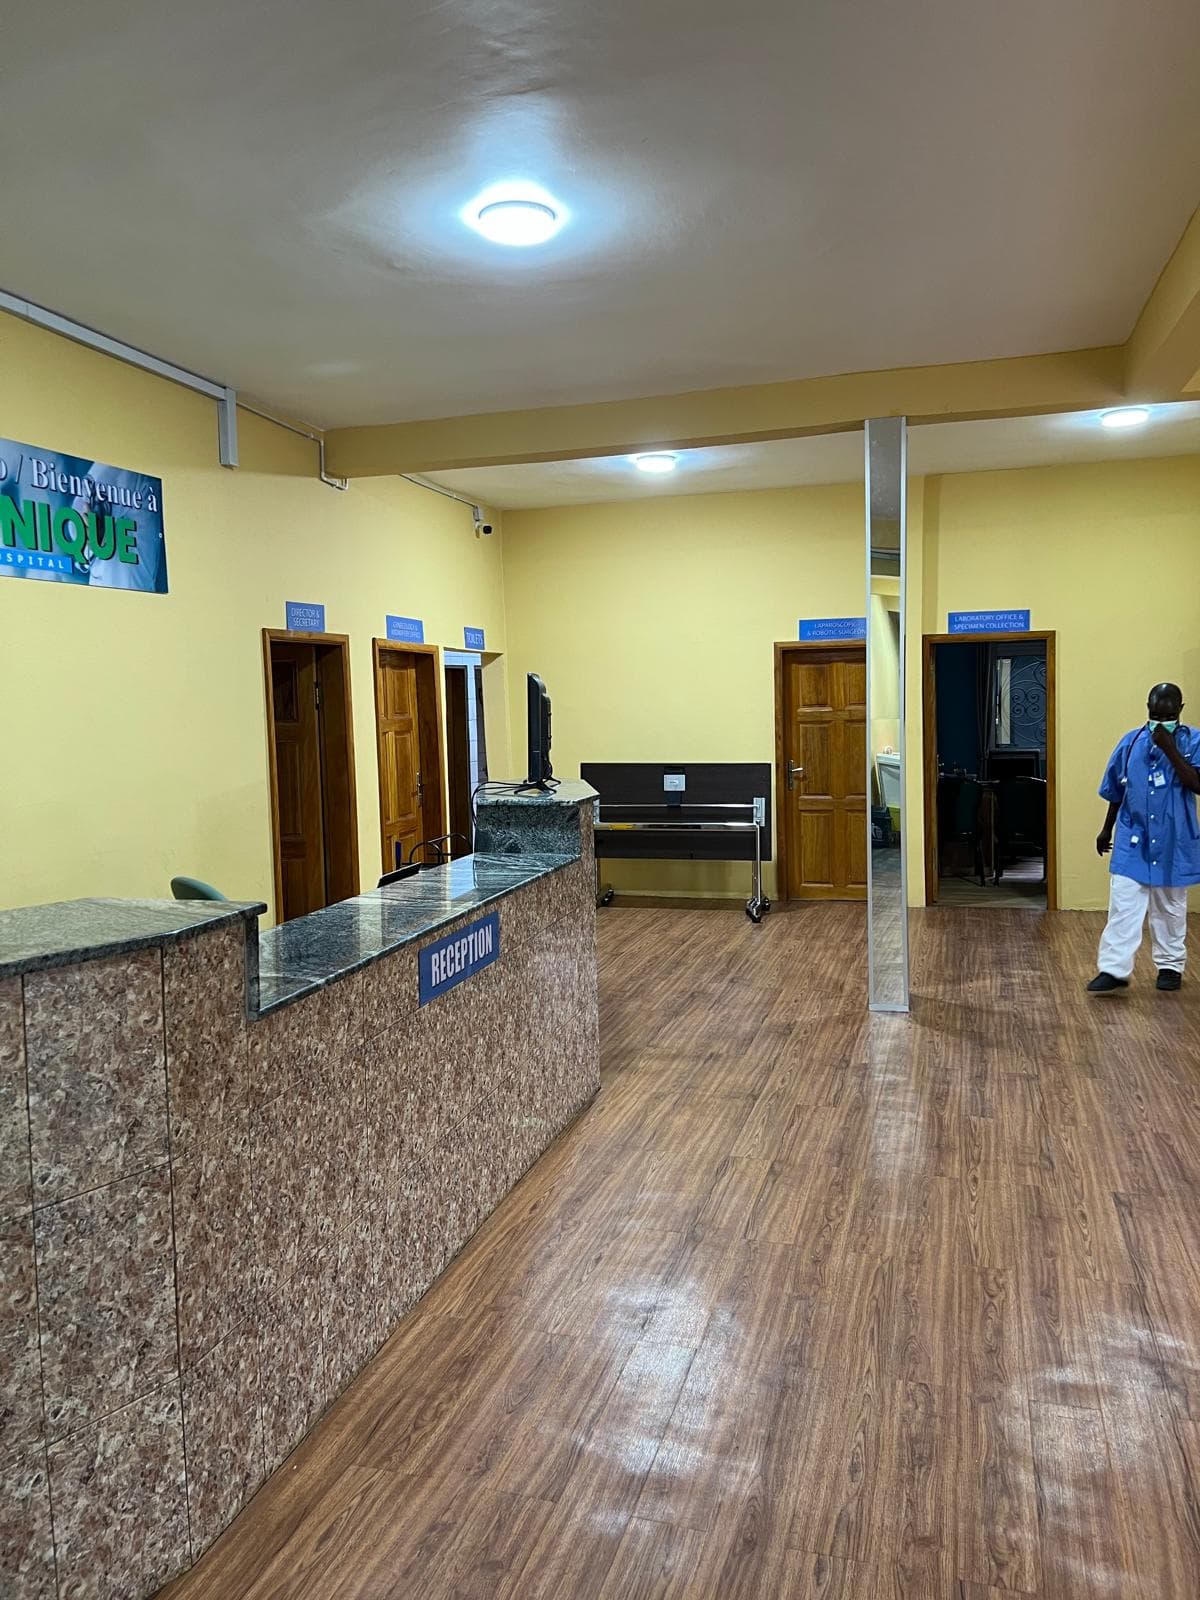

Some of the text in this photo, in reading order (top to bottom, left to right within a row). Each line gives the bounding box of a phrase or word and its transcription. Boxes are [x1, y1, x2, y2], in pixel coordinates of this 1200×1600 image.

[30, 457, 142, 509] Bienvenue
[148, 486, 158, 512] à
[0, 552, 65, 570] SPITAL
[954, 621, 1025, 631] SPECIMEN COLLECTION
[431, 923, 493, 988] RECEPTION
